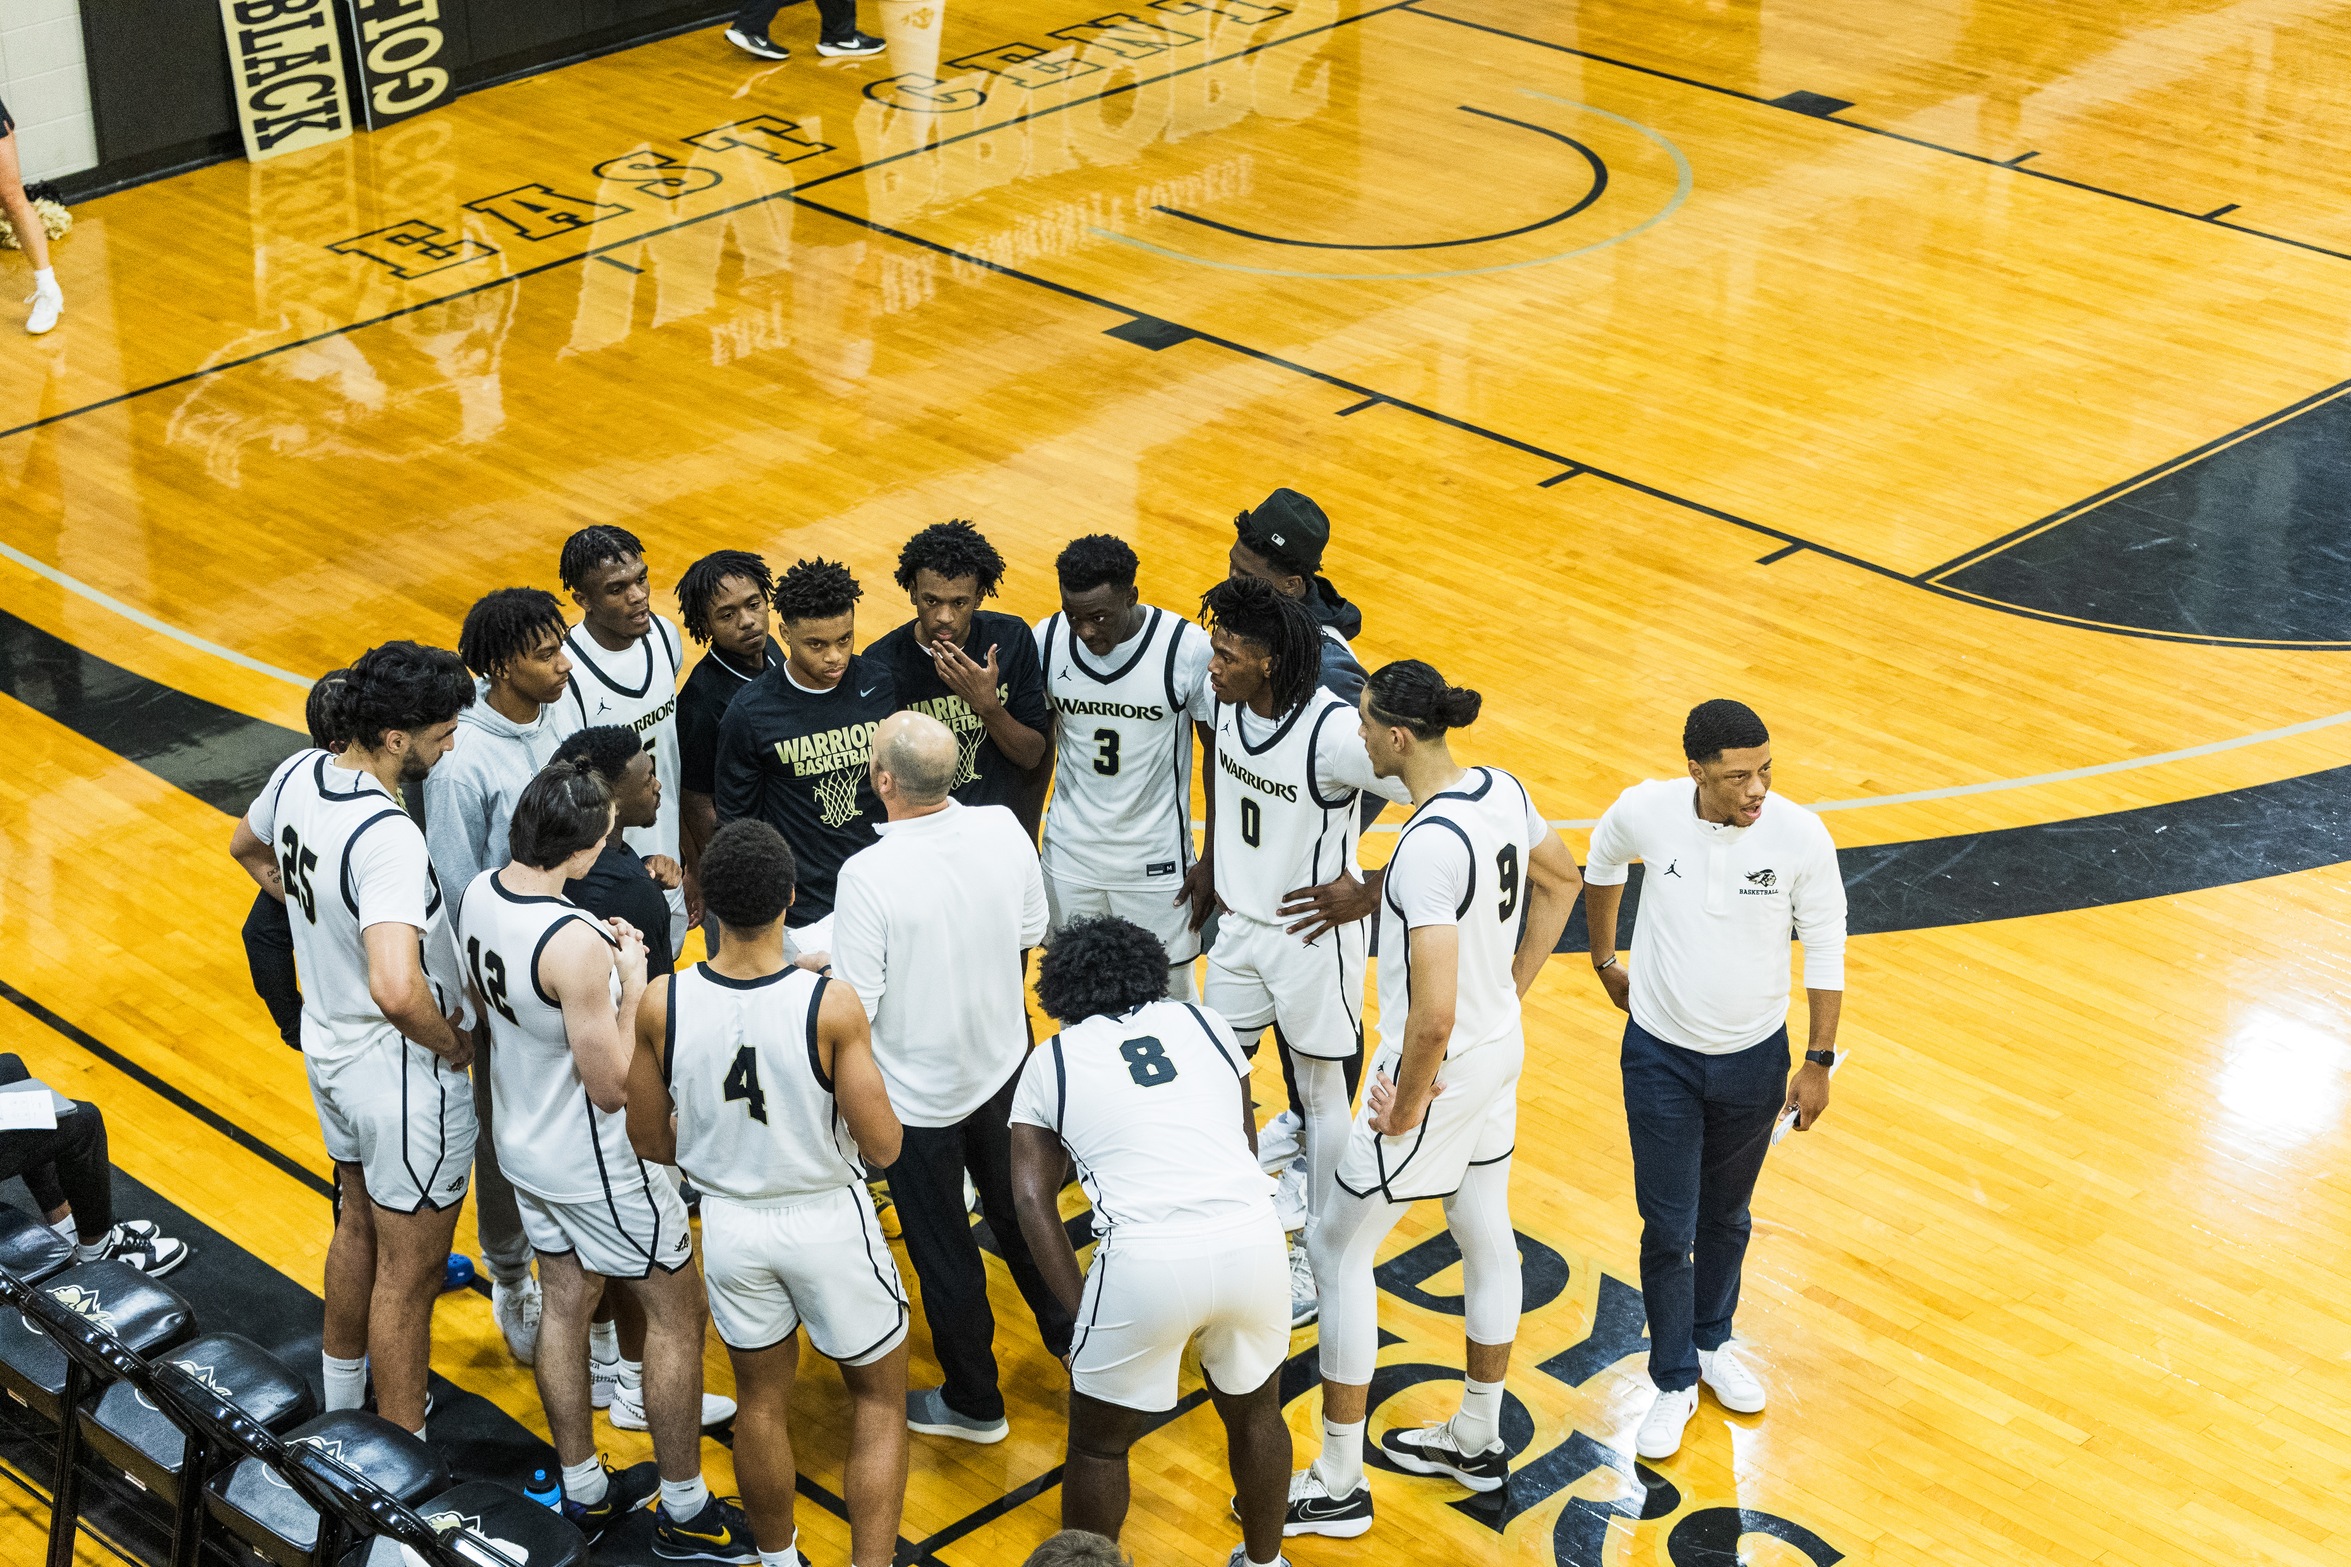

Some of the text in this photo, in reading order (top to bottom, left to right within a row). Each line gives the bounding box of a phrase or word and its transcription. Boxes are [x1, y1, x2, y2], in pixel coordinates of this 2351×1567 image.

[233, 0, 342, 151] BLACK
[359, 0, 449, 115] GOL
[325, 114, 836, 279] EAST
[1054, 697, 1163, 721] WARRIORS
[1093, 728, 1120, 776] 3
[1219, 748, 1298, 803] WARRIORS
[1240, 797, 1261, 849] 0
[281, 824, 318, 925] 25
[1496, 842, 1519, 923] 9
[1738, 888, 1779, 896] BASKETBALL
[467, 935, 520, 1028] 12
[723, 1044, 768, 1126] 4
[1119, 1035, 1178, 1087] 8
